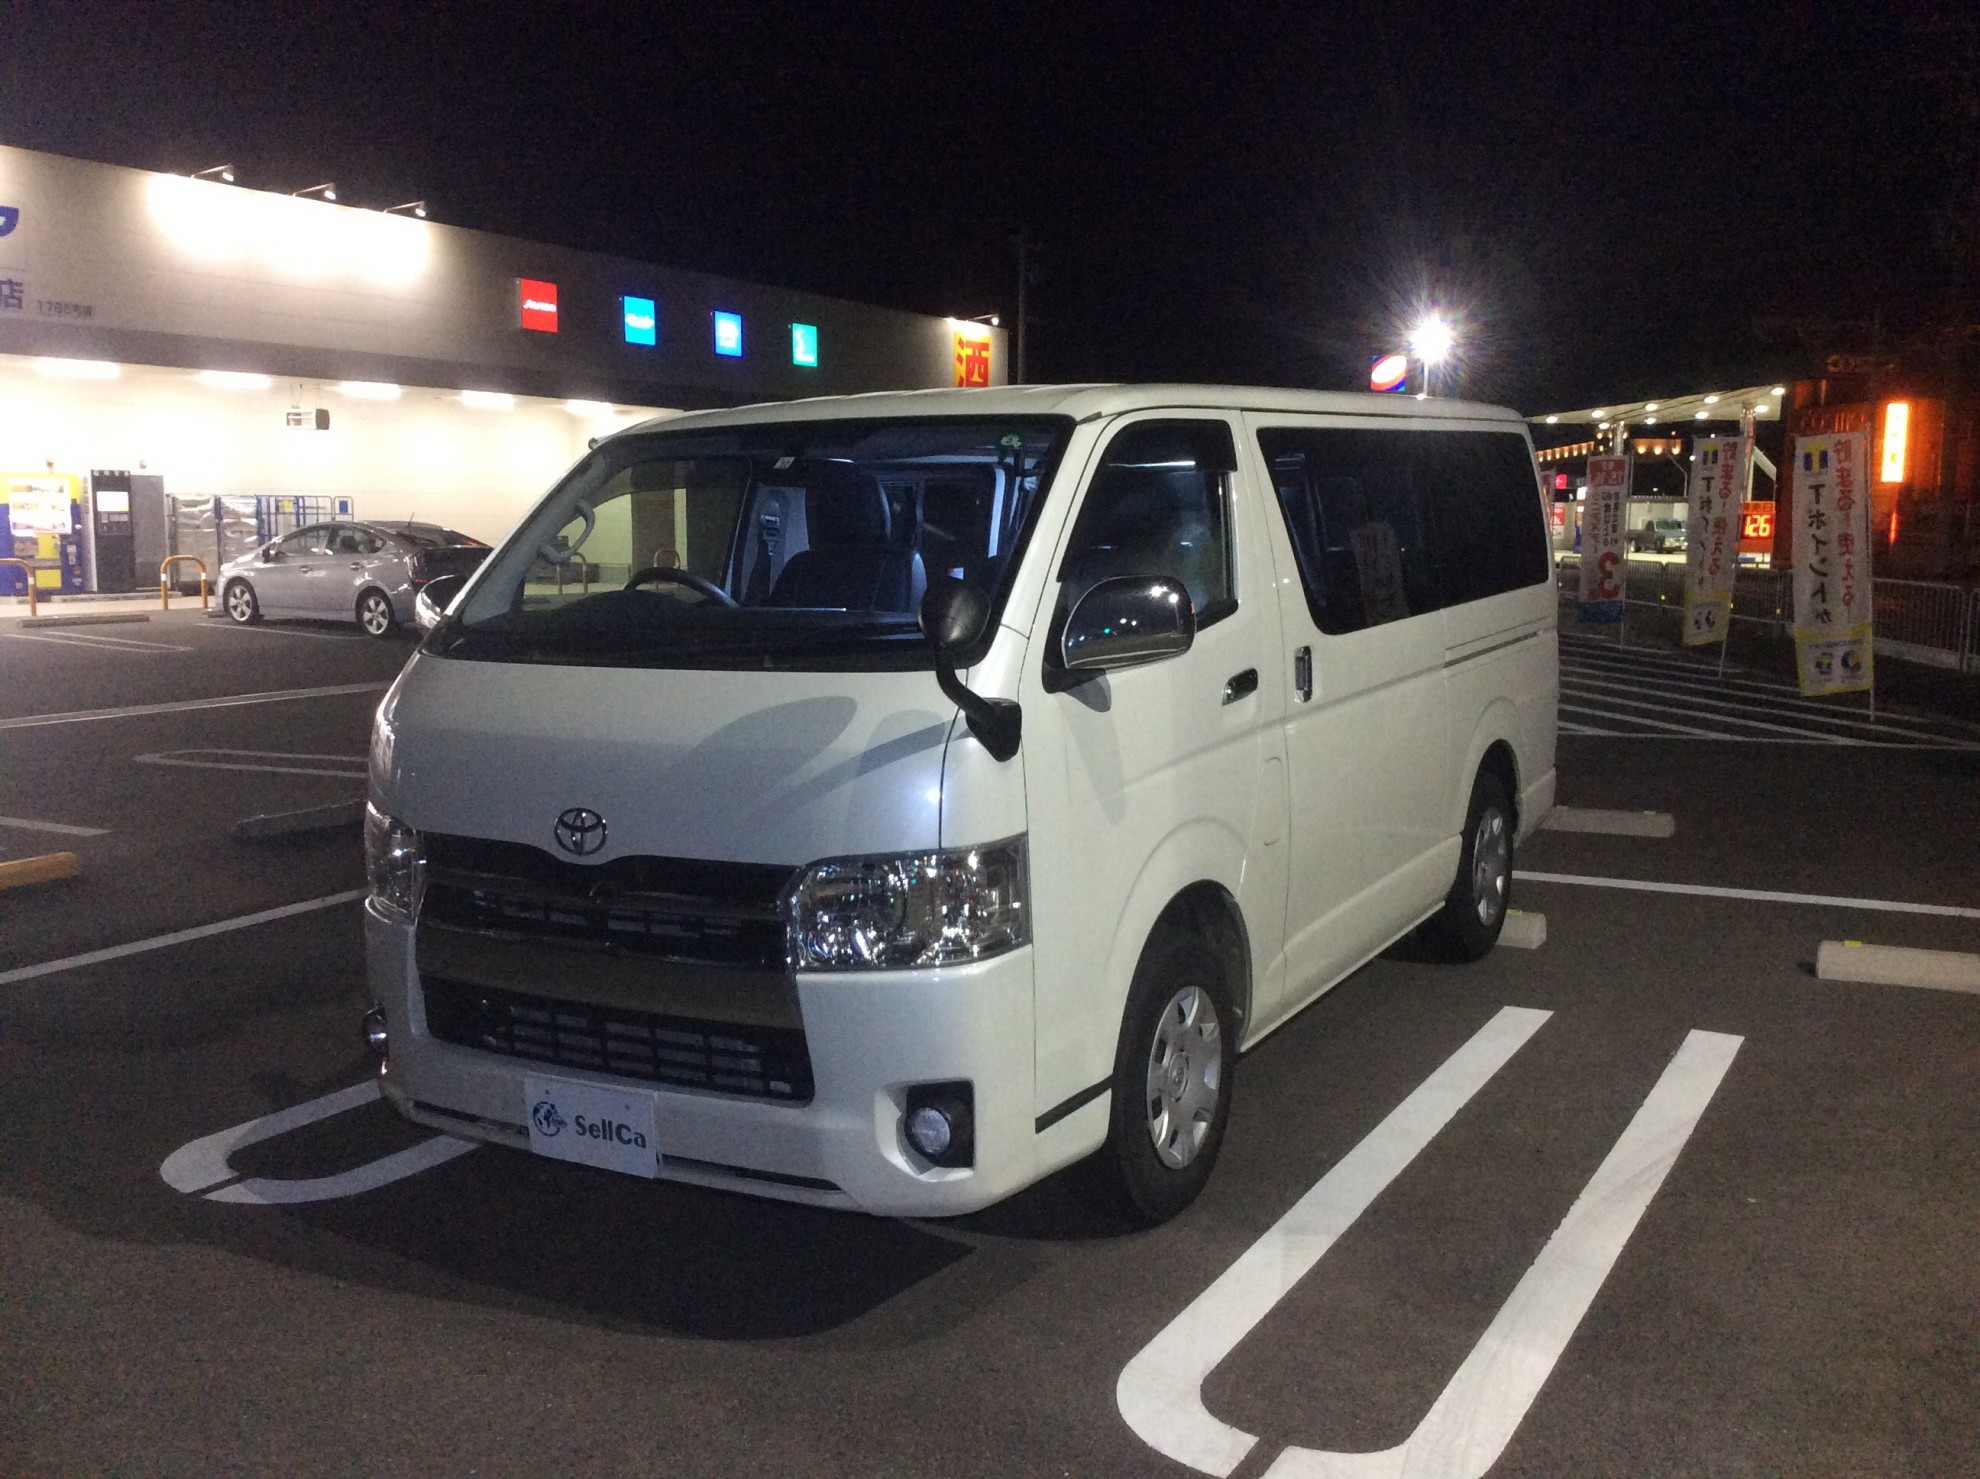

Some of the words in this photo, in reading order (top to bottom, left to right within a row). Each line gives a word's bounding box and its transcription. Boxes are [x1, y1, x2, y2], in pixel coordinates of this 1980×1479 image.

[956, 337, 989, 388] 酒
[1744, 514, 1771, 537] 126
[574, 1114, 648, 1149] SellCa
